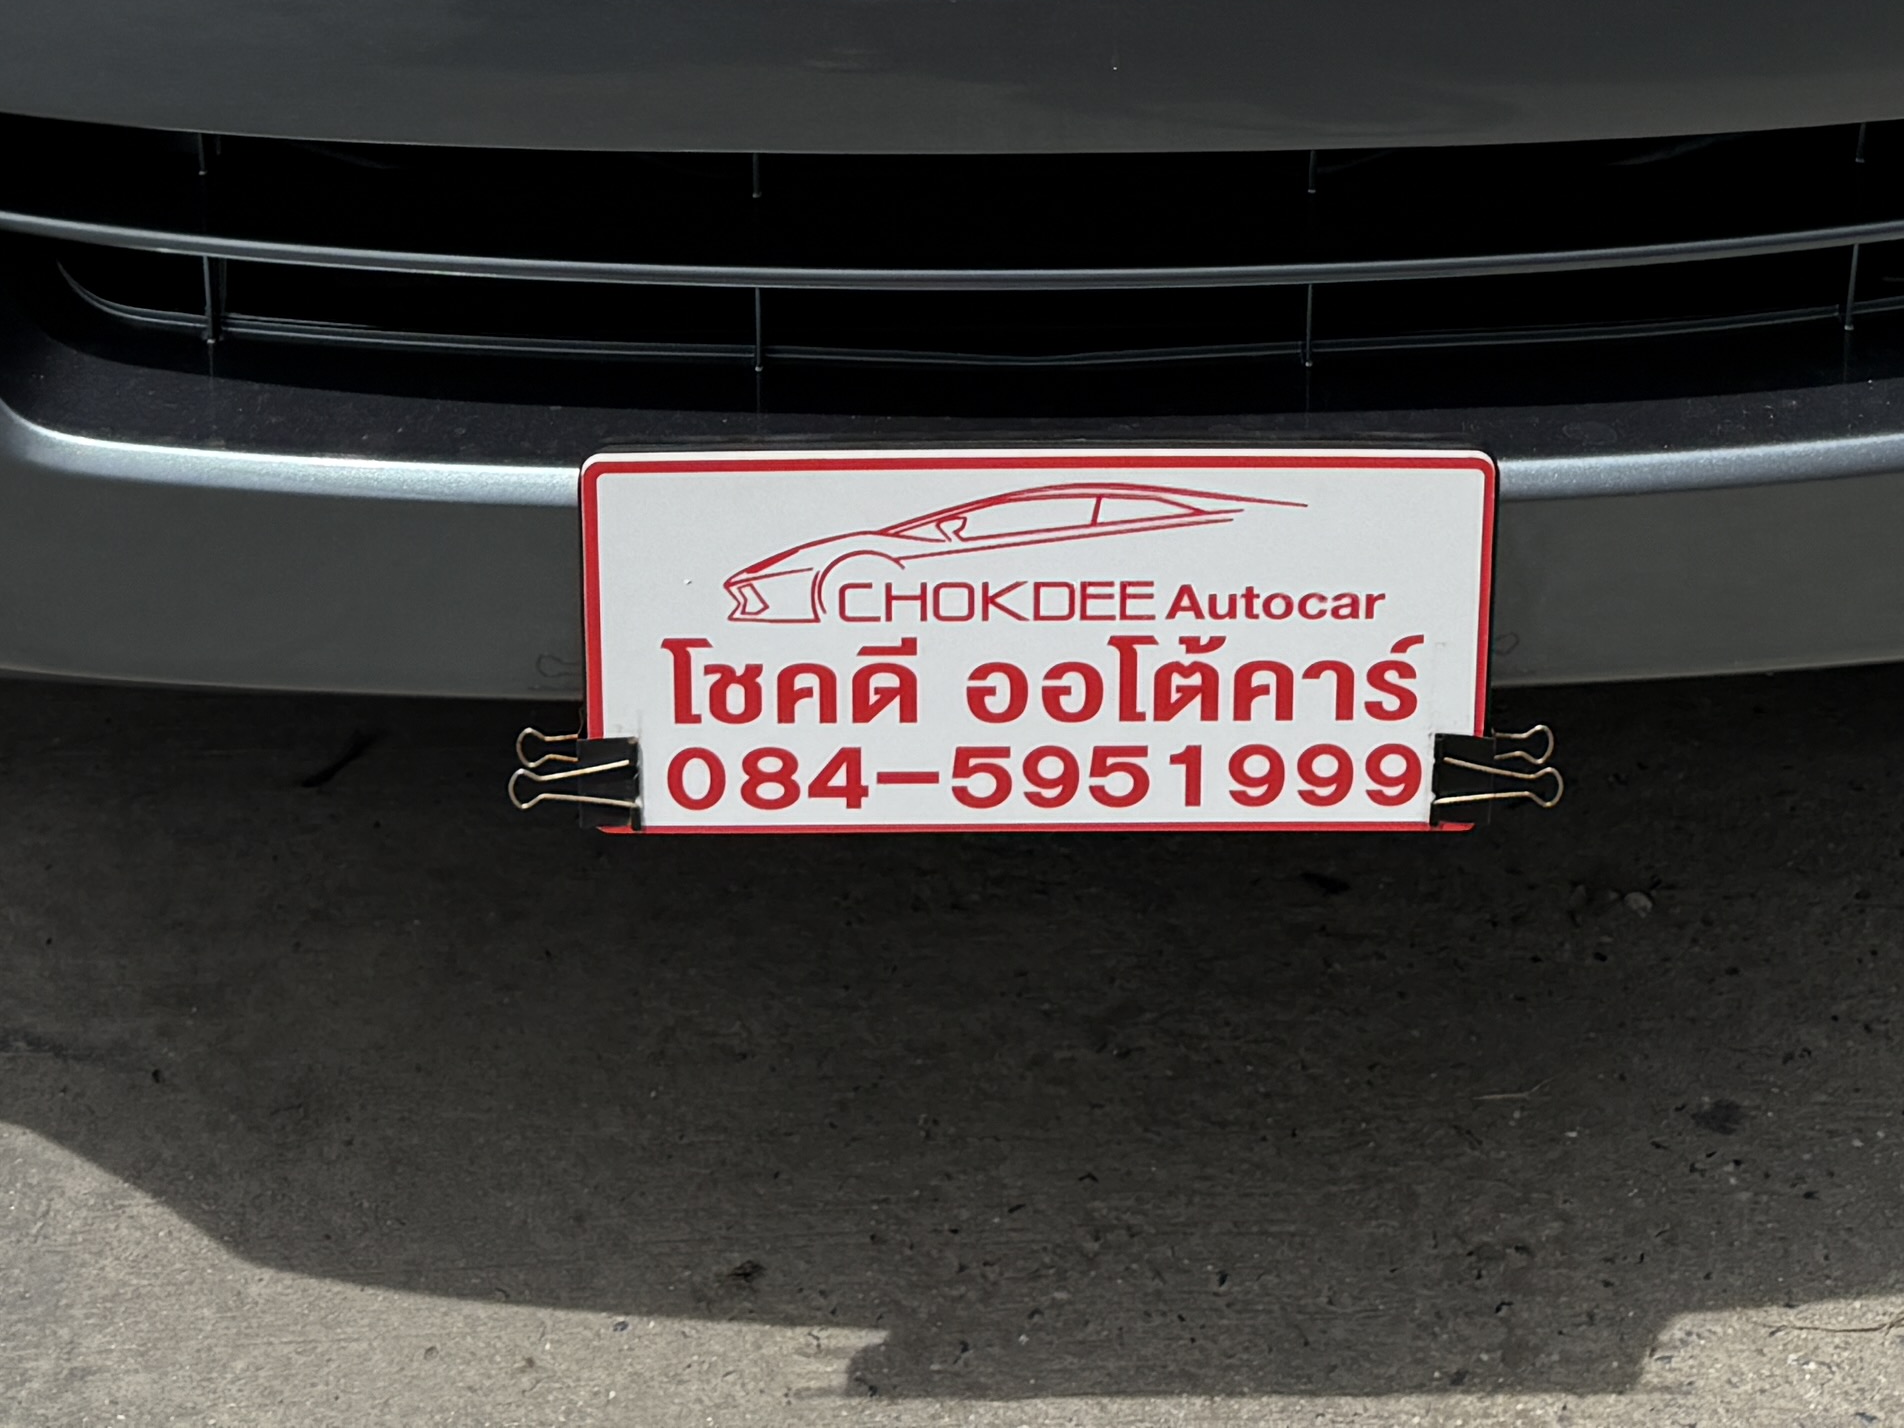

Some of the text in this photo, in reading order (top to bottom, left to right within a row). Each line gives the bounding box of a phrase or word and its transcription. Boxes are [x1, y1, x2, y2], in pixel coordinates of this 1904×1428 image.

[837, 580, 1387, 623] CHOKDEE Autocar
[659, 633, 1426, 726] โชคดี ออโต้คาร์
[665, 742, 1424, 811] 084-5951999
